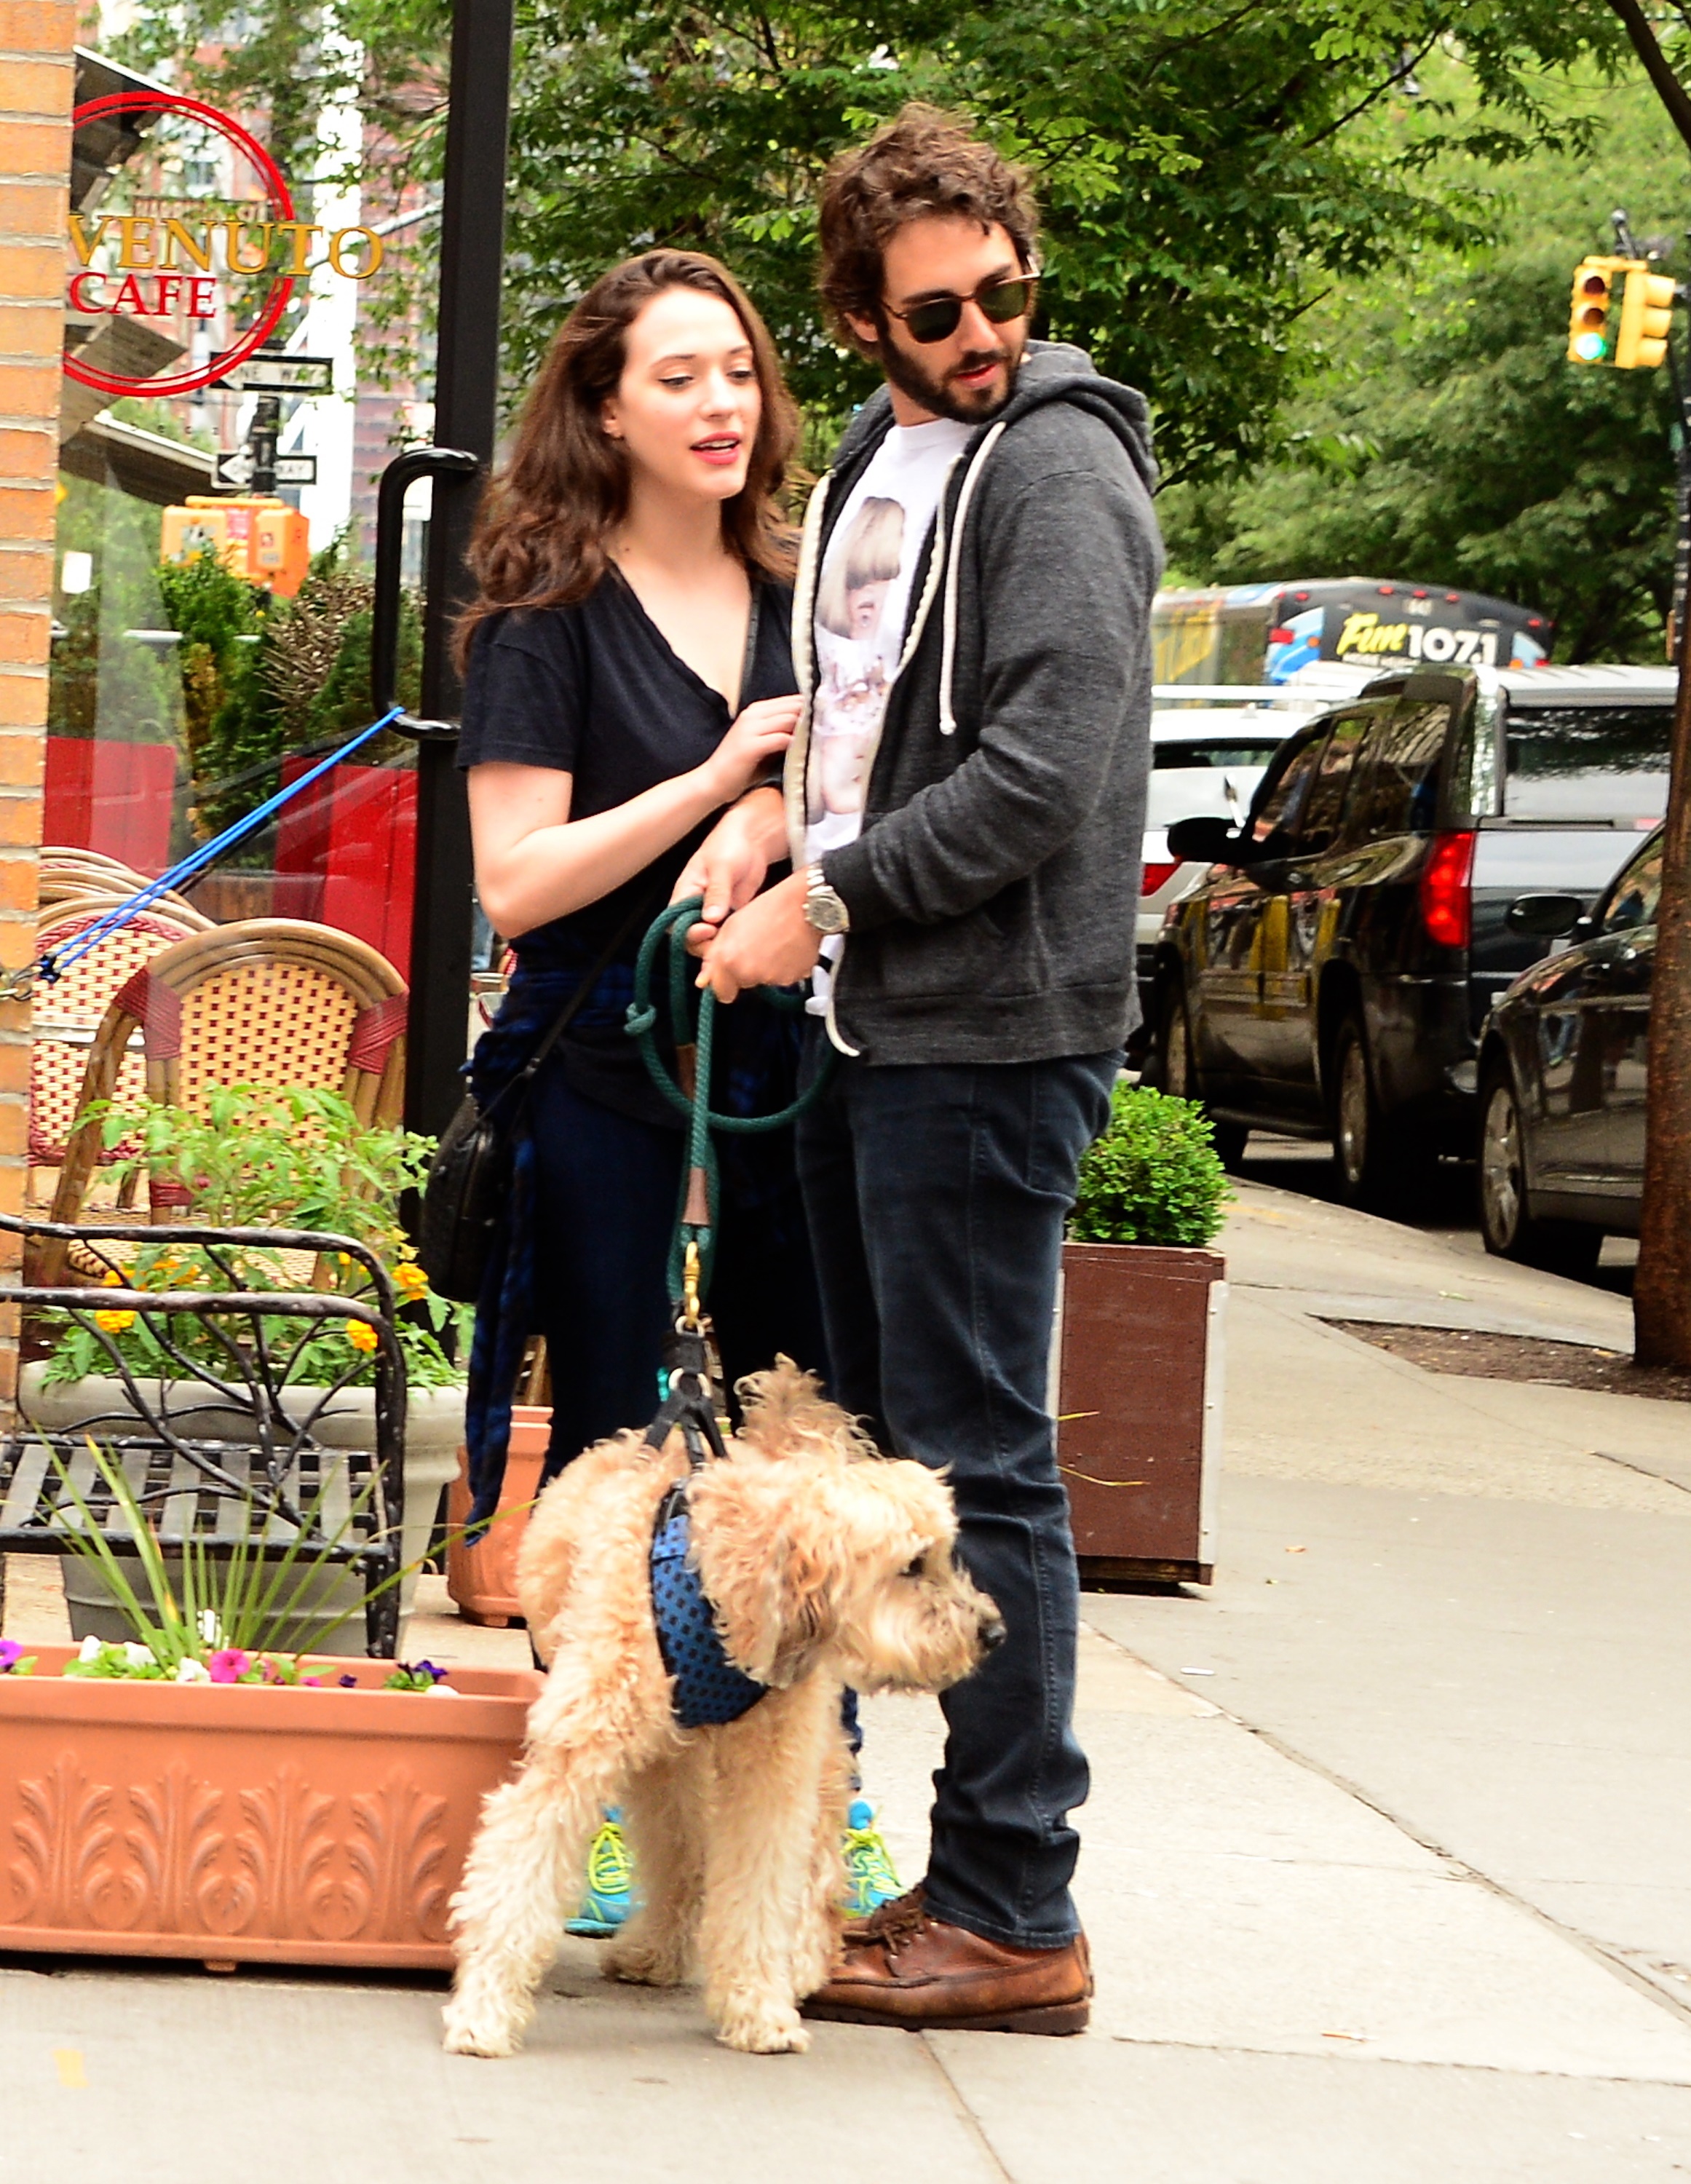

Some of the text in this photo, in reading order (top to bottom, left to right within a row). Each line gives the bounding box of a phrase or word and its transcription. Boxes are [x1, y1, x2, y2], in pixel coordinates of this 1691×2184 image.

[68, 213, 384, 280] VENUTO
[68, 271, 217, 318] CAFE
[1336, 612, 1499, 665] Fun 107.1
